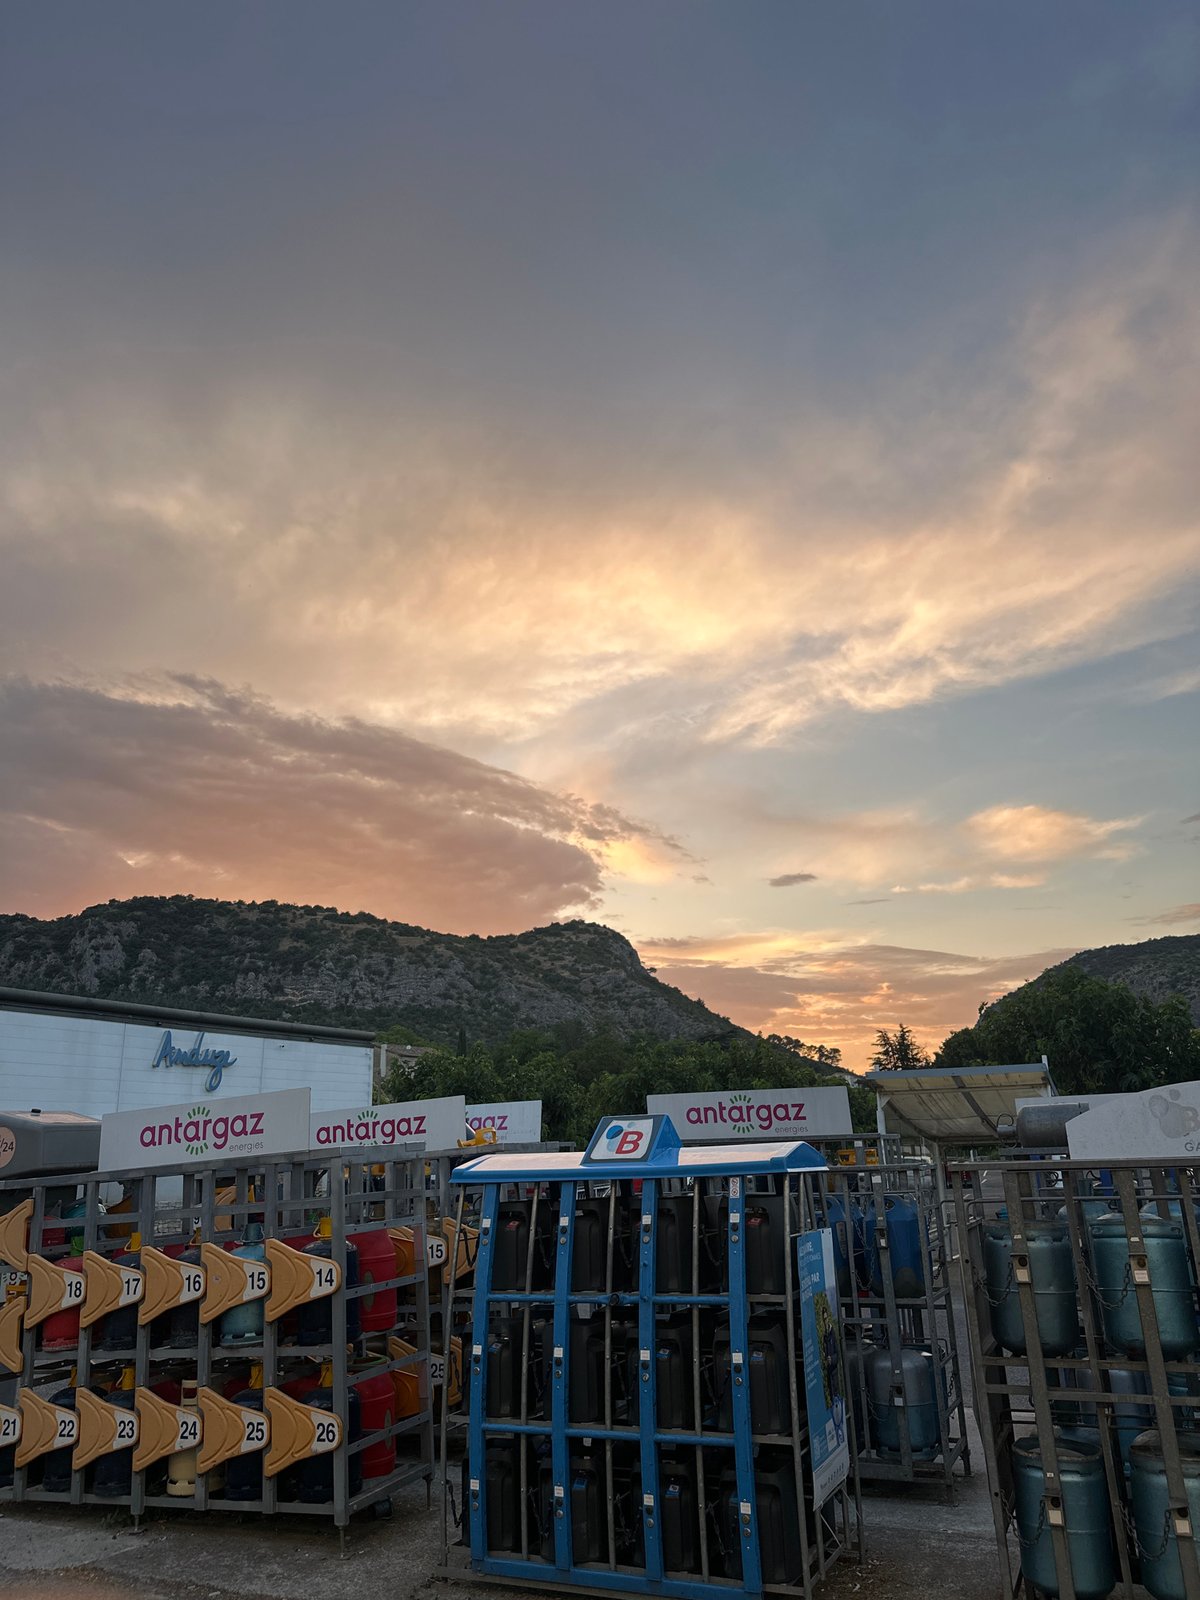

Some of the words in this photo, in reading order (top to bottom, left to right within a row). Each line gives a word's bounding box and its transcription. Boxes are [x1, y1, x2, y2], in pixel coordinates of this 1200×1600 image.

[466, 1115, 508, 1131] gaz
[686, 1101, 807, 1130] antargaz
[140, 1112, 265, 1150] antargaz
[316, 1115, 427, 1145] antargaz
[775, 1125, 808, 1135] energies
[0, 1138, 14, 1153] /24
[229, 1141, 264, 1154] energies
[615, 1131, 644, 1154] B
[428, 1244, 443, 1259] 15
[125, 1277, 141, 1295] 17
[185, 1274, 201, 1293] 16
[248, 1271, 266, 1290] 15
[316, 1267, 334, 1287] 14
[67, 1281, 82, 1299] 18
[431, 1363, 444, 1378] 25
[2, 1419, 17, 1436] 21
[59, 1420, 74, 1437] 22
[118, 1420, 134, 1439] 23
[180, 1421, 197, 1440] 24
[246, 1421, 264, 1441] 25
[316, 1423, 335, 1443] 26
